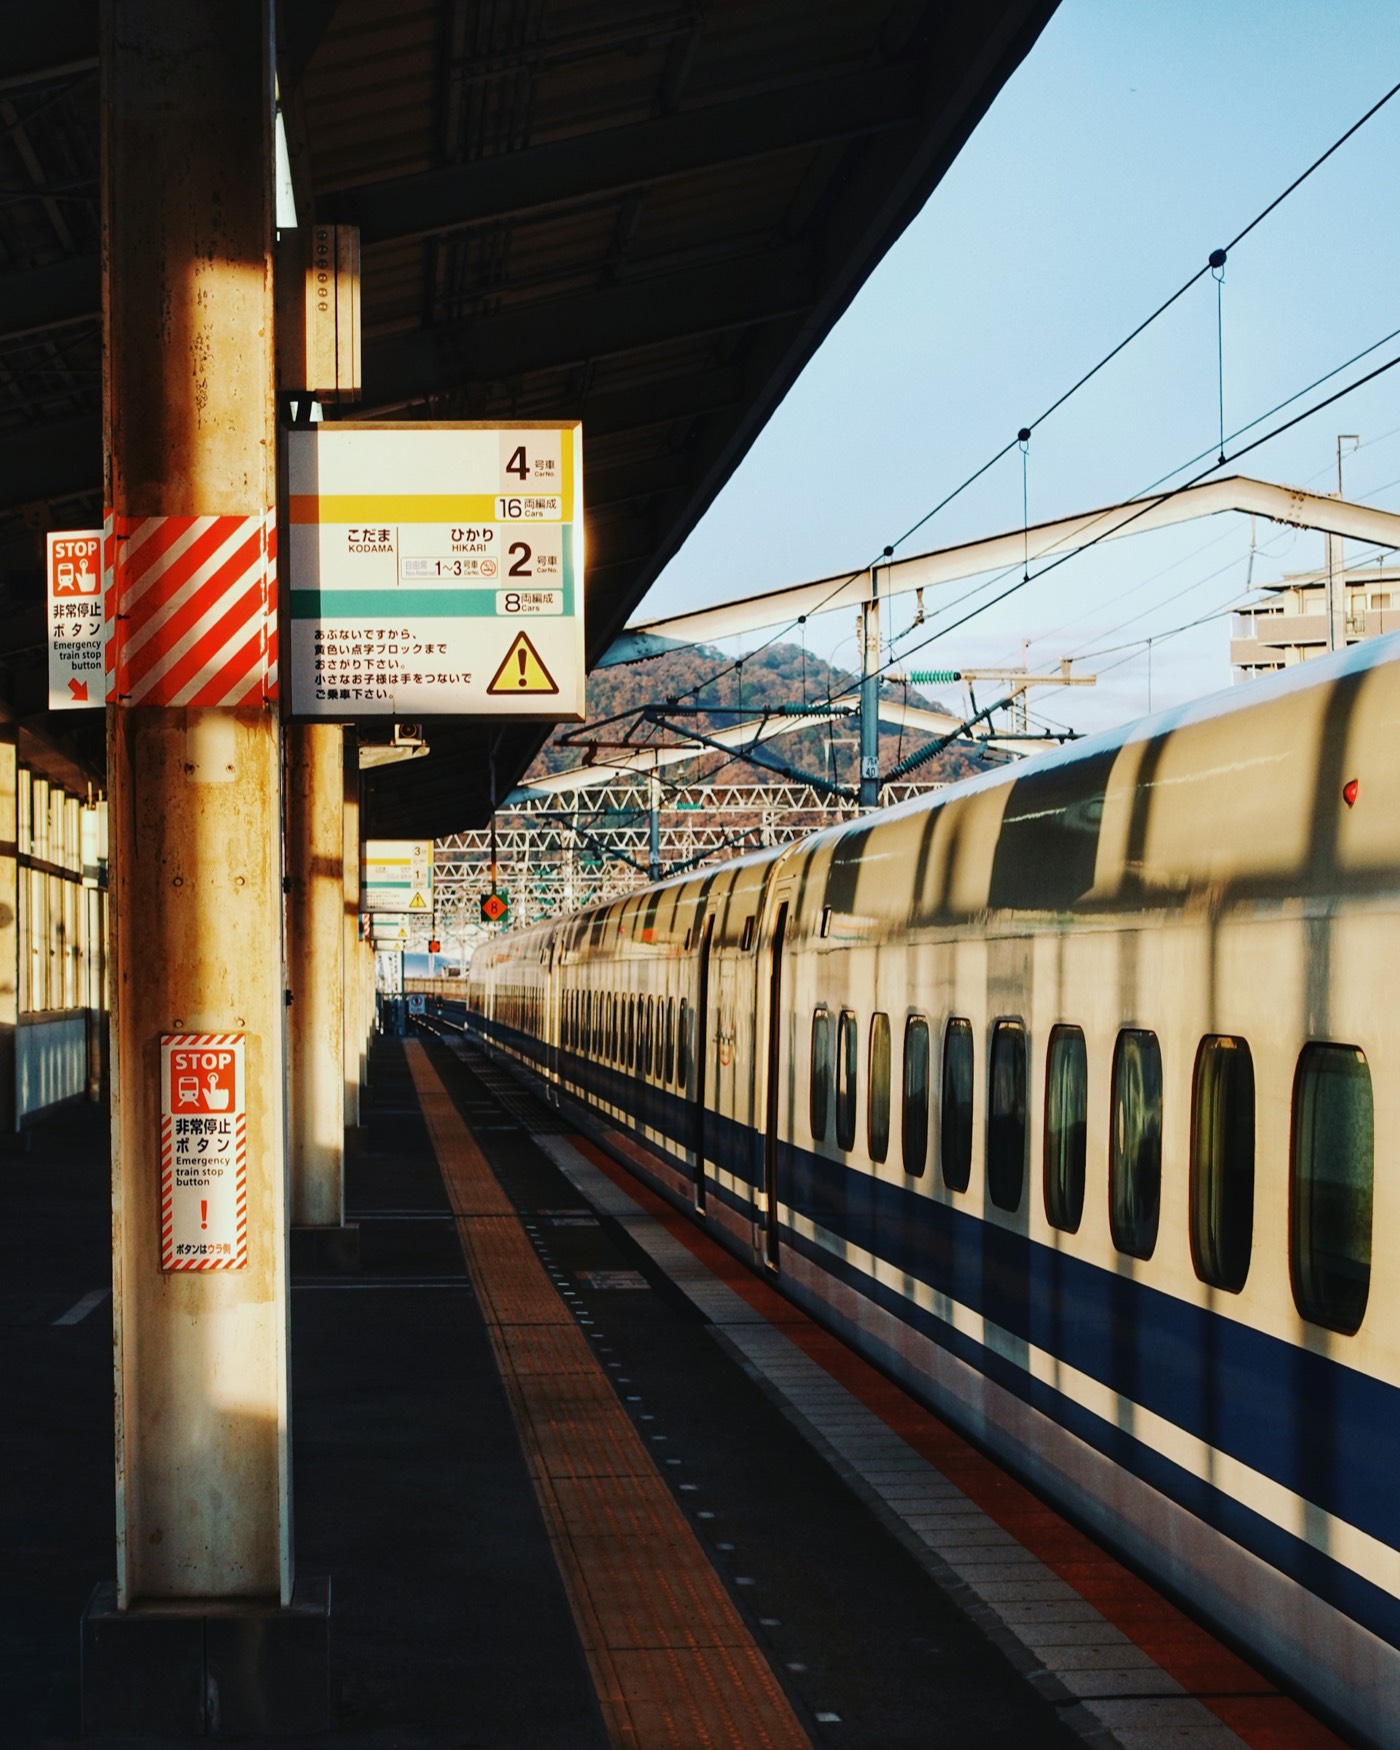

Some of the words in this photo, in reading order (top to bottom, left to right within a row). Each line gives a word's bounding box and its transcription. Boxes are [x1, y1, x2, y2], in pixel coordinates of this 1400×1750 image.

[506, 446, 530, 480] 4
[535, 460, 555, 470] 号車
[500, 498, 522, 518] 16
[524, 498, 556, 509] 両編成
[348, 529, 391, 543] こだま
[451, 528, 494, 542] ひかり
[55, 541, 98, 558] STOP
[348, 544, 394, 553] KODAMA
[451, 544, 487, 552] HIKARI
[508, 542, 532, 577] 2
[537, 555, 557, 566] 号車
[505, 593, 521, 612] 8
[521, 592, 553, 604] 両編成
[521, 604, 541, 612] Cars
[53, 602, 102, 619] 非常停止
[53, 623, 101, 638] ボタン
[314, 629, 417, 640] あぶないですから、
[53, 640, 102, 651] Emergency
[314, 644, 447, 655] 黄色い点字ブロックまで
[59, 651, 80, 660] train
[82, 650, 102, 661] stop
[71, 660, 102, 670] button
[314, 659, 405, 670] おさがり下さい。
[314, 673, 472, 685] 小さなお子様は手をつないで
[315, 688, 394, 700] ご乗車下さい。
[414, 846, 421, 856] 3
[175, 1053, 232, 1070] STOP
[176, 1118, 232, 1135] 非常停止
[176, 1137, 230, 1154] ボタン
[176, 1157, 231, 1167] Emergency
[176, 1167, 199, 1176] train
[202, 1168, 224, 1178] stop
[176, 1178, 210, 1187] button
[176, 1243, 231, 1255] ボタンはウラ側
